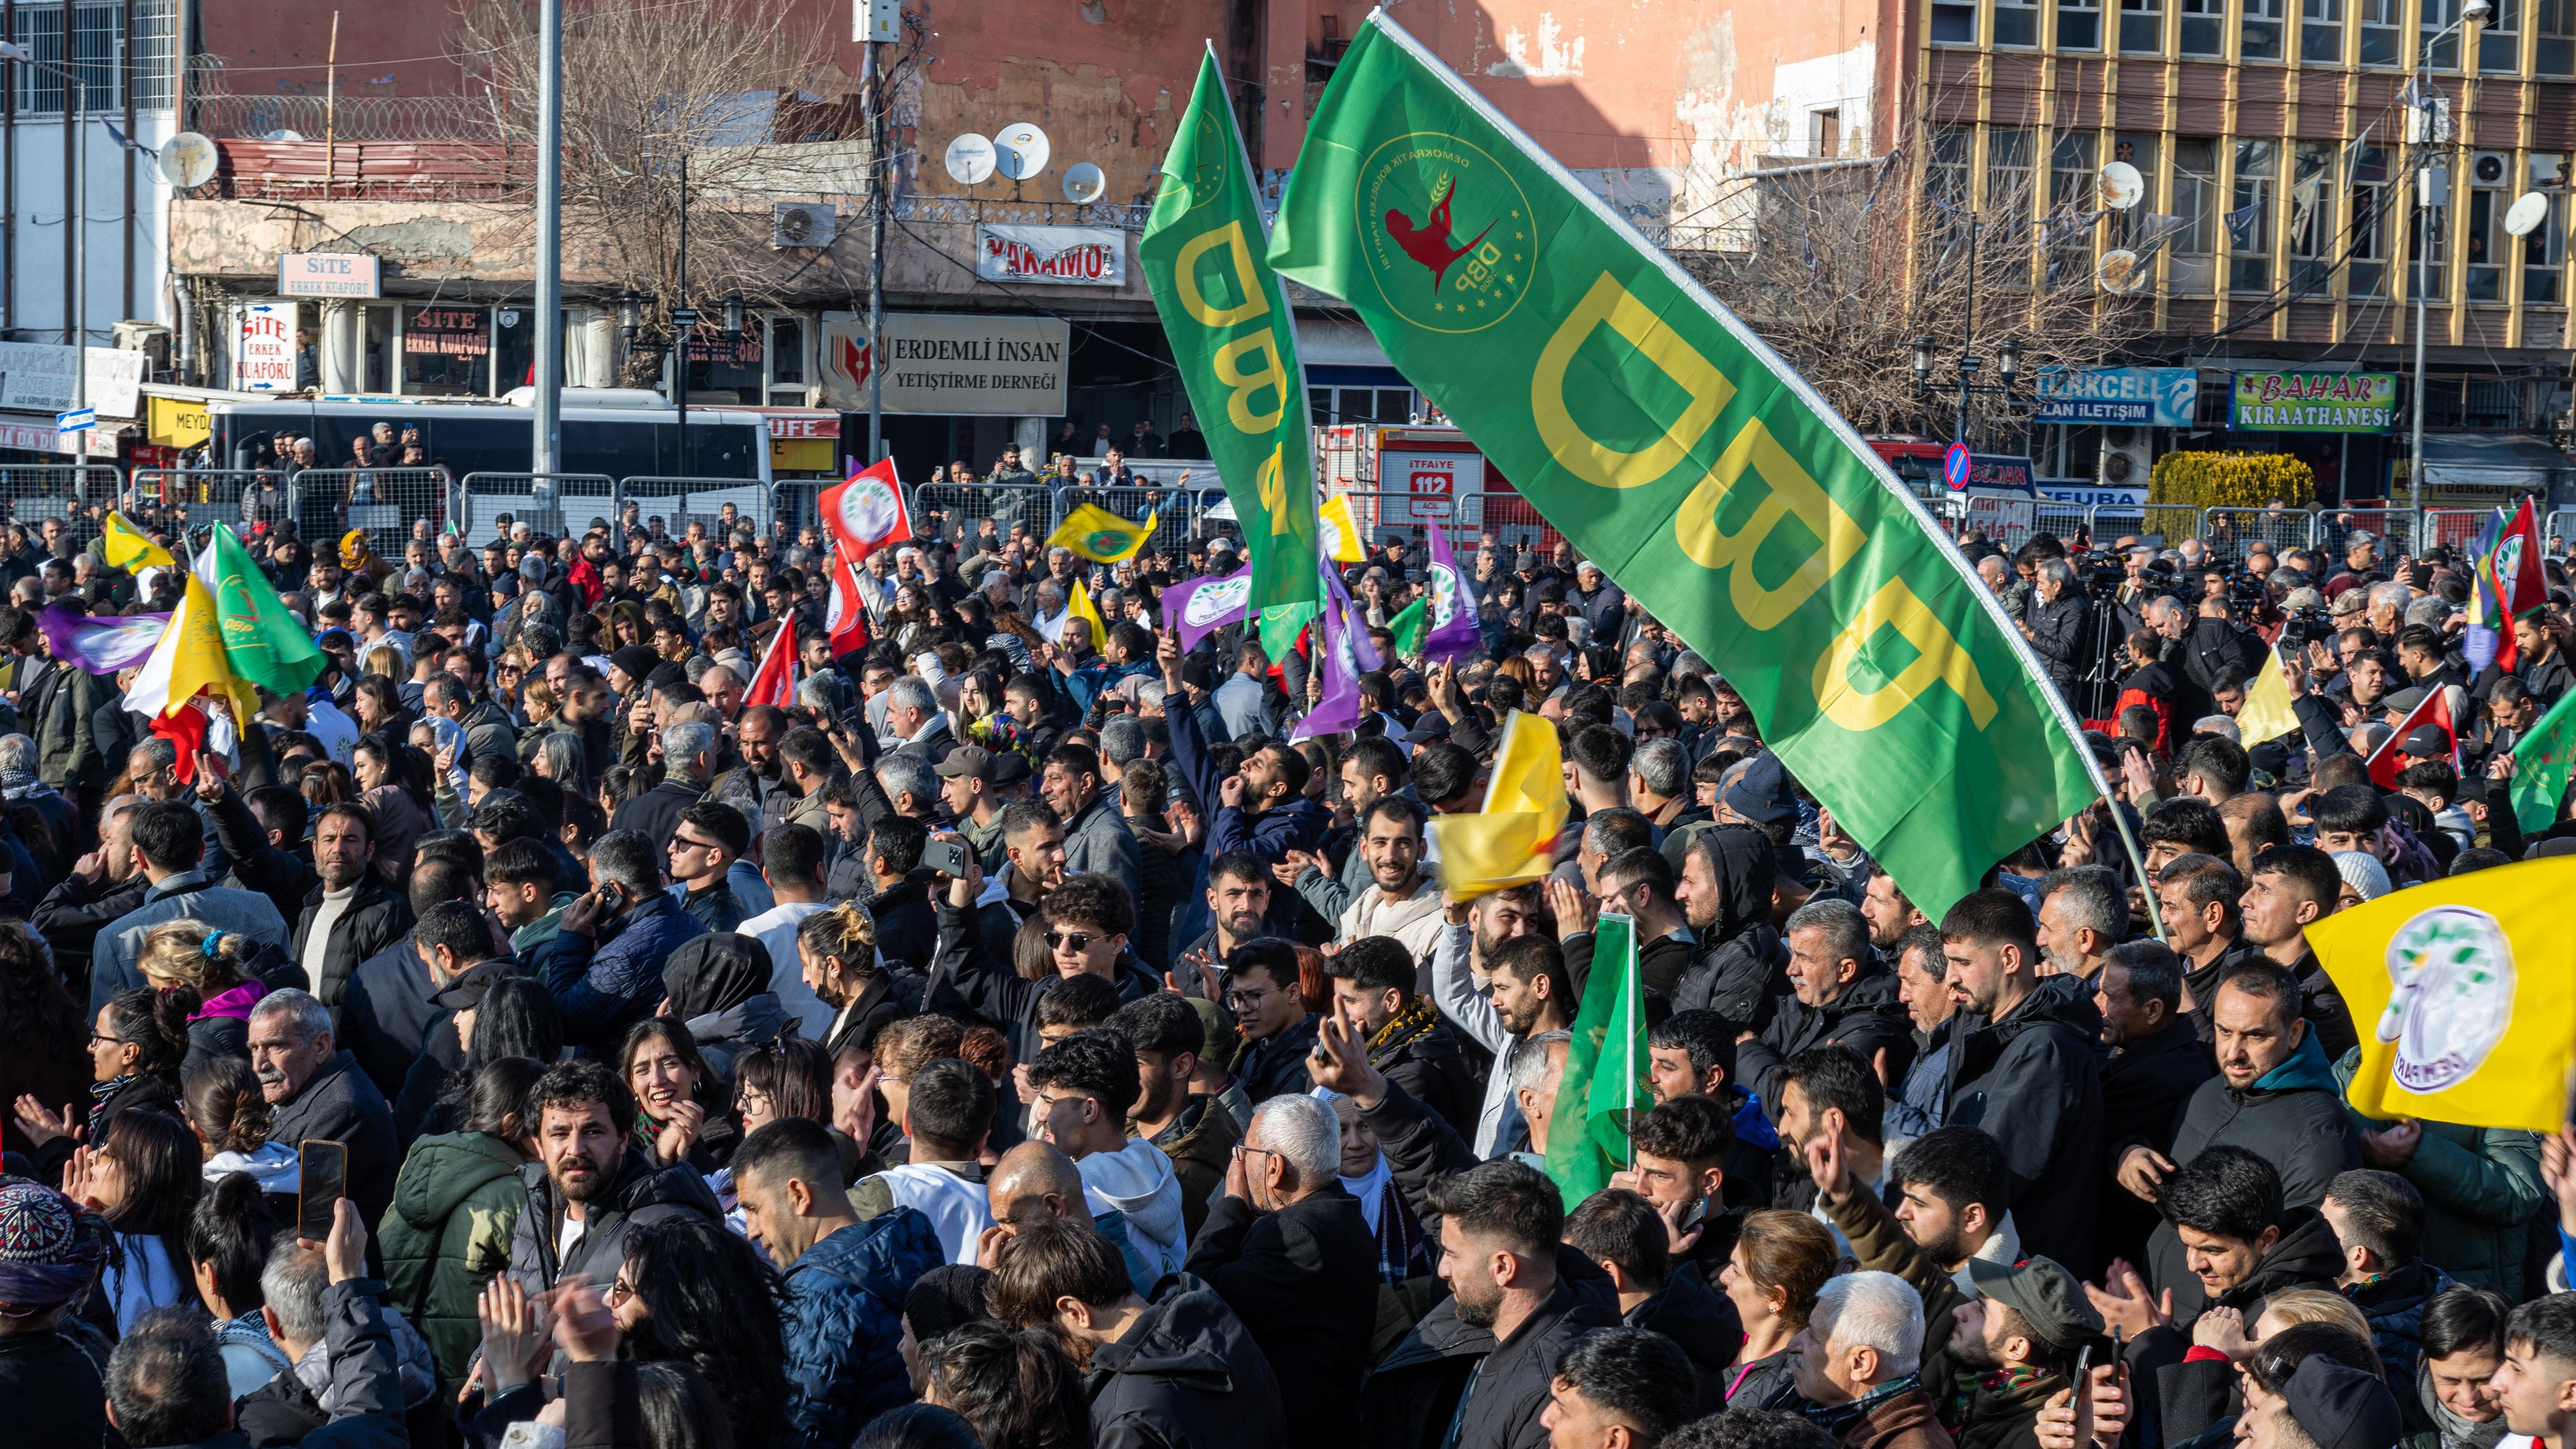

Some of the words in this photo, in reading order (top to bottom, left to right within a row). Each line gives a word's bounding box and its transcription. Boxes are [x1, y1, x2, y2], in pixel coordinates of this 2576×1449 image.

[984, 235, 1114, 279] YAKAMO
[290, 280, 323, 293] ERKEK
[325, 279, 369, 295] KUAFÖRÜ
[248, 343, 282, 356] ERKEK
[405, 333, 438, 353] ERKEK
[439, 332, 488, 356] KUAFÖRÜ
[895, 337, 991, 361] ERDEMLİ
[996, 337, 1061, 362] İNSAN
[235, 358, 293, 380] KUAFÖRÜ
[896, 371, 987, 392] YETİŞTİRME
[991, 372, 1057, 390] DERNEĞİ
[2260, 374, 2373, 403] BAHAR
[2037, 403, 2074, 417] LAN
[176, 413, 211, 430] MEYD
[767, 418, 818, 437] ÜFE
[1415, 476, 1446, 493] 112
[224, 618, 255, 632] DBP
